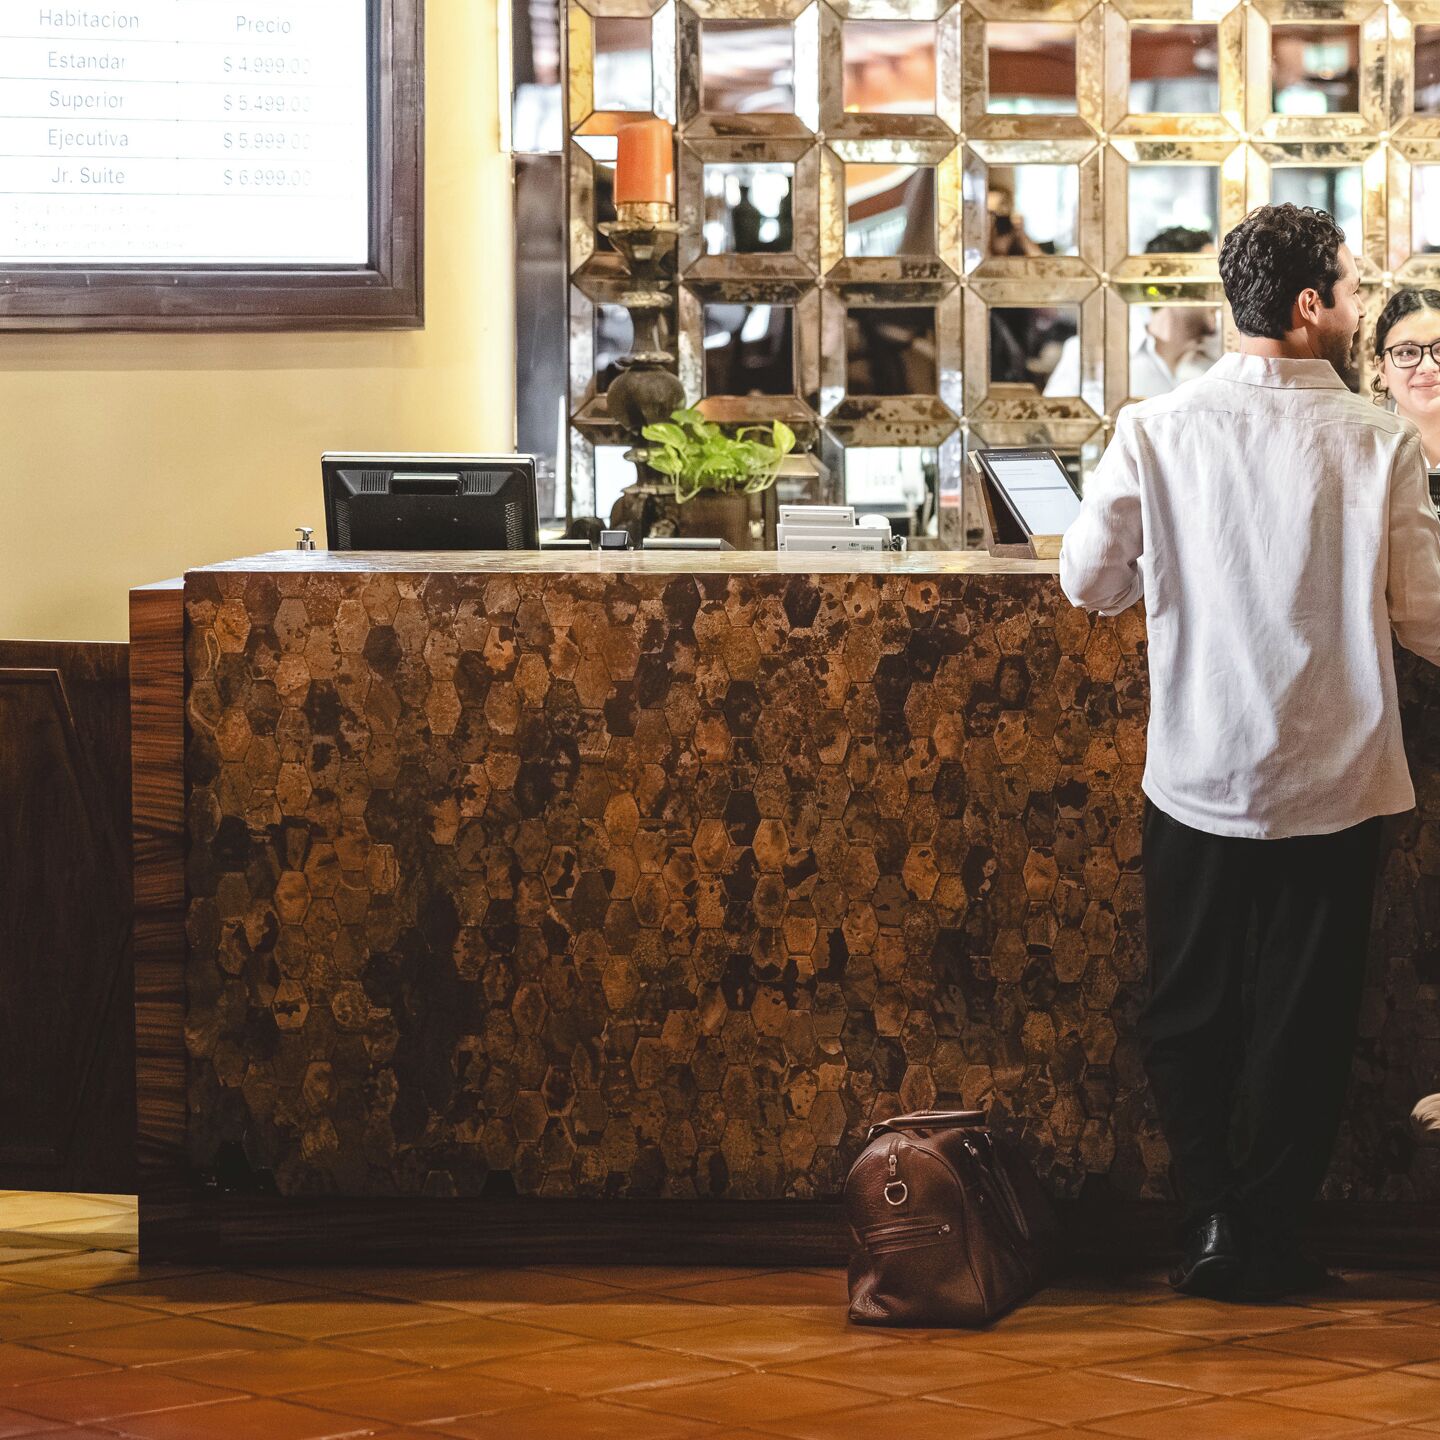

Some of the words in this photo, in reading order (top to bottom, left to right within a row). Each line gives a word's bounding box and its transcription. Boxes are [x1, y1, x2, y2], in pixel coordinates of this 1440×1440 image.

[39, 9, 140, 29] Habitacion
[236, 15, 291, 34] Precio
[47, 51, 127, 71] Estandar
[223, 56, 233, 74] $
[49, 90, 125, 110] Superior
[223, 94, 233, 112] $
[47, 129, 129, 150] Ejecutiva
[223, 132, 233, 149] $
[238, 132, 312, 150] 5.99900
[51, 166, 74, 185] Jr.
[79, 167, 126, 185] Suite
[223, 169, 233, 186] $
